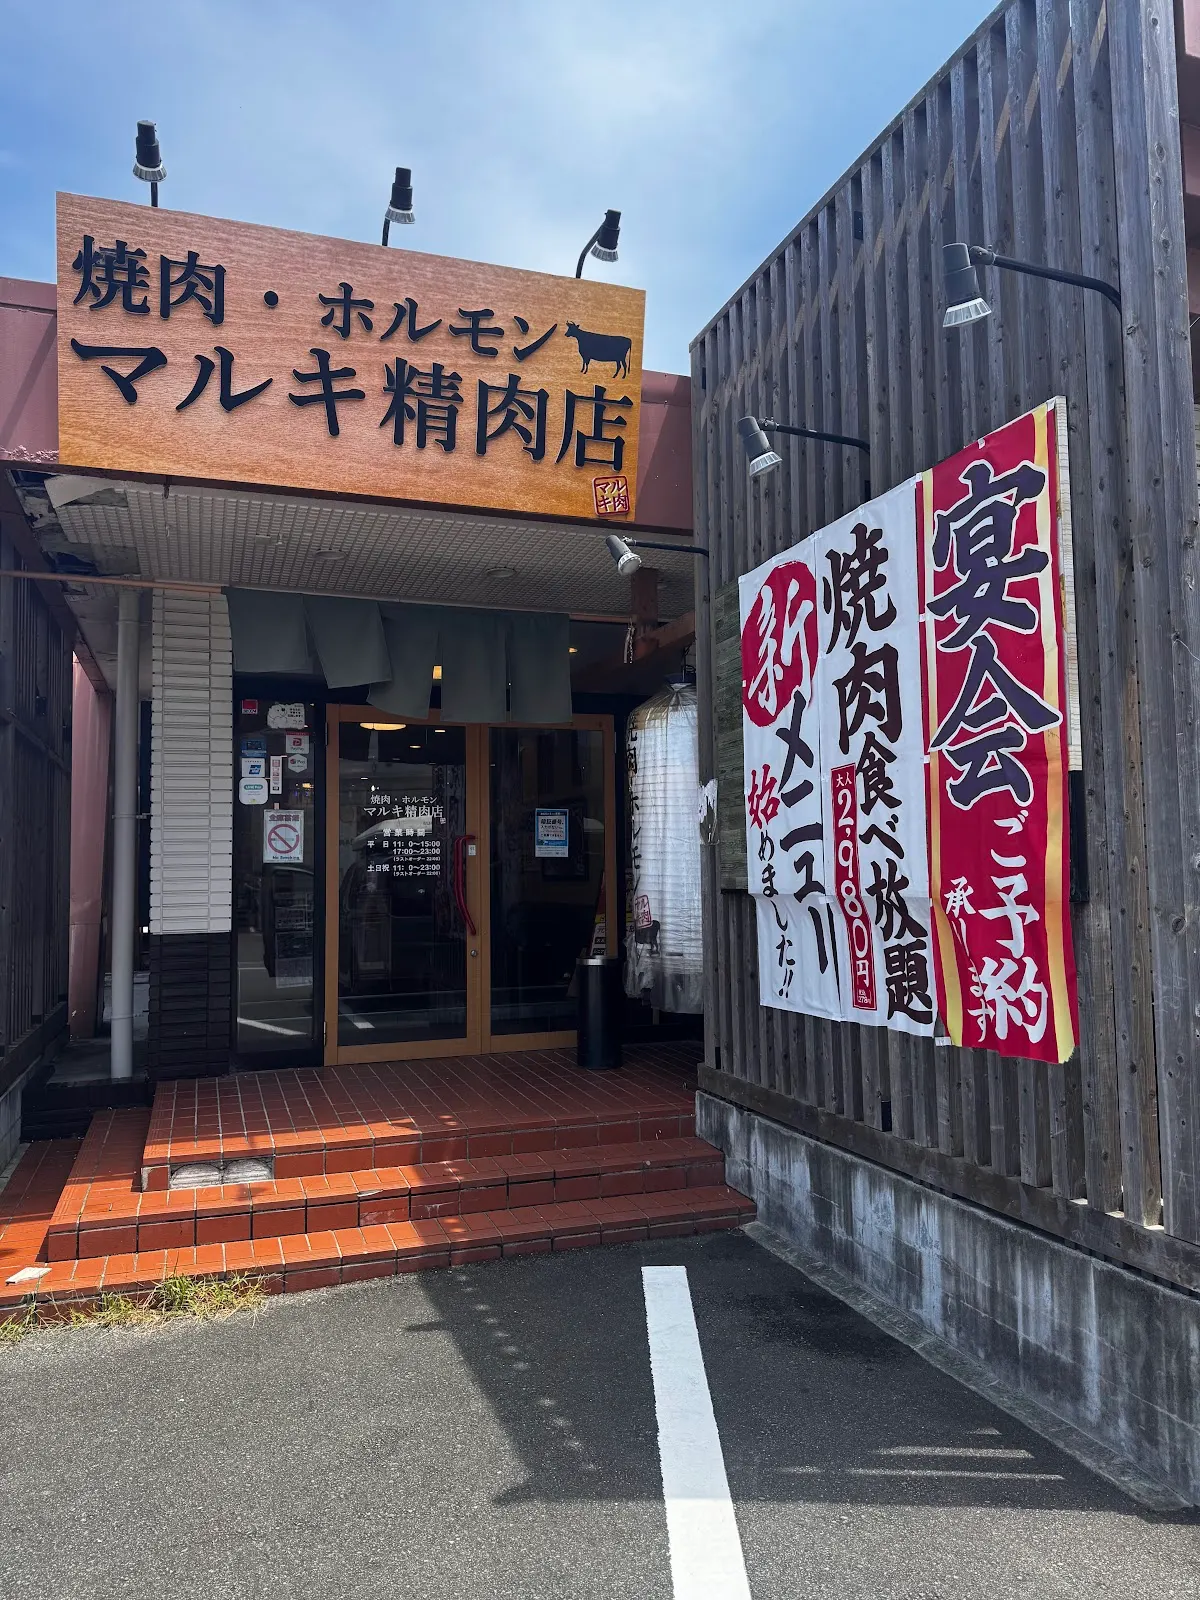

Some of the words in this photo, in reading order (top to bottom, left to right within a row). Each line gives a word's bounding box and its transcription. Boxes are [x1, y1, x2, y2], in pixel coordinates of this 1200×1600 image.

[71, 234, 558, 362] 焼肉・ホルモン
[70, 337, 634, 471] マルキ精肉店
[370, 794, 437, 804] 焼肉・ホルモン
[822, 522, 933, 1025] 焼肉食べ放題
[363, 805, 444, 818] マルキ精肉店
[382, 828, 426, 837] 営業時間
[367, 863, 390, 872] 土日祝
[943, 875, 997, 1043] 承ります
